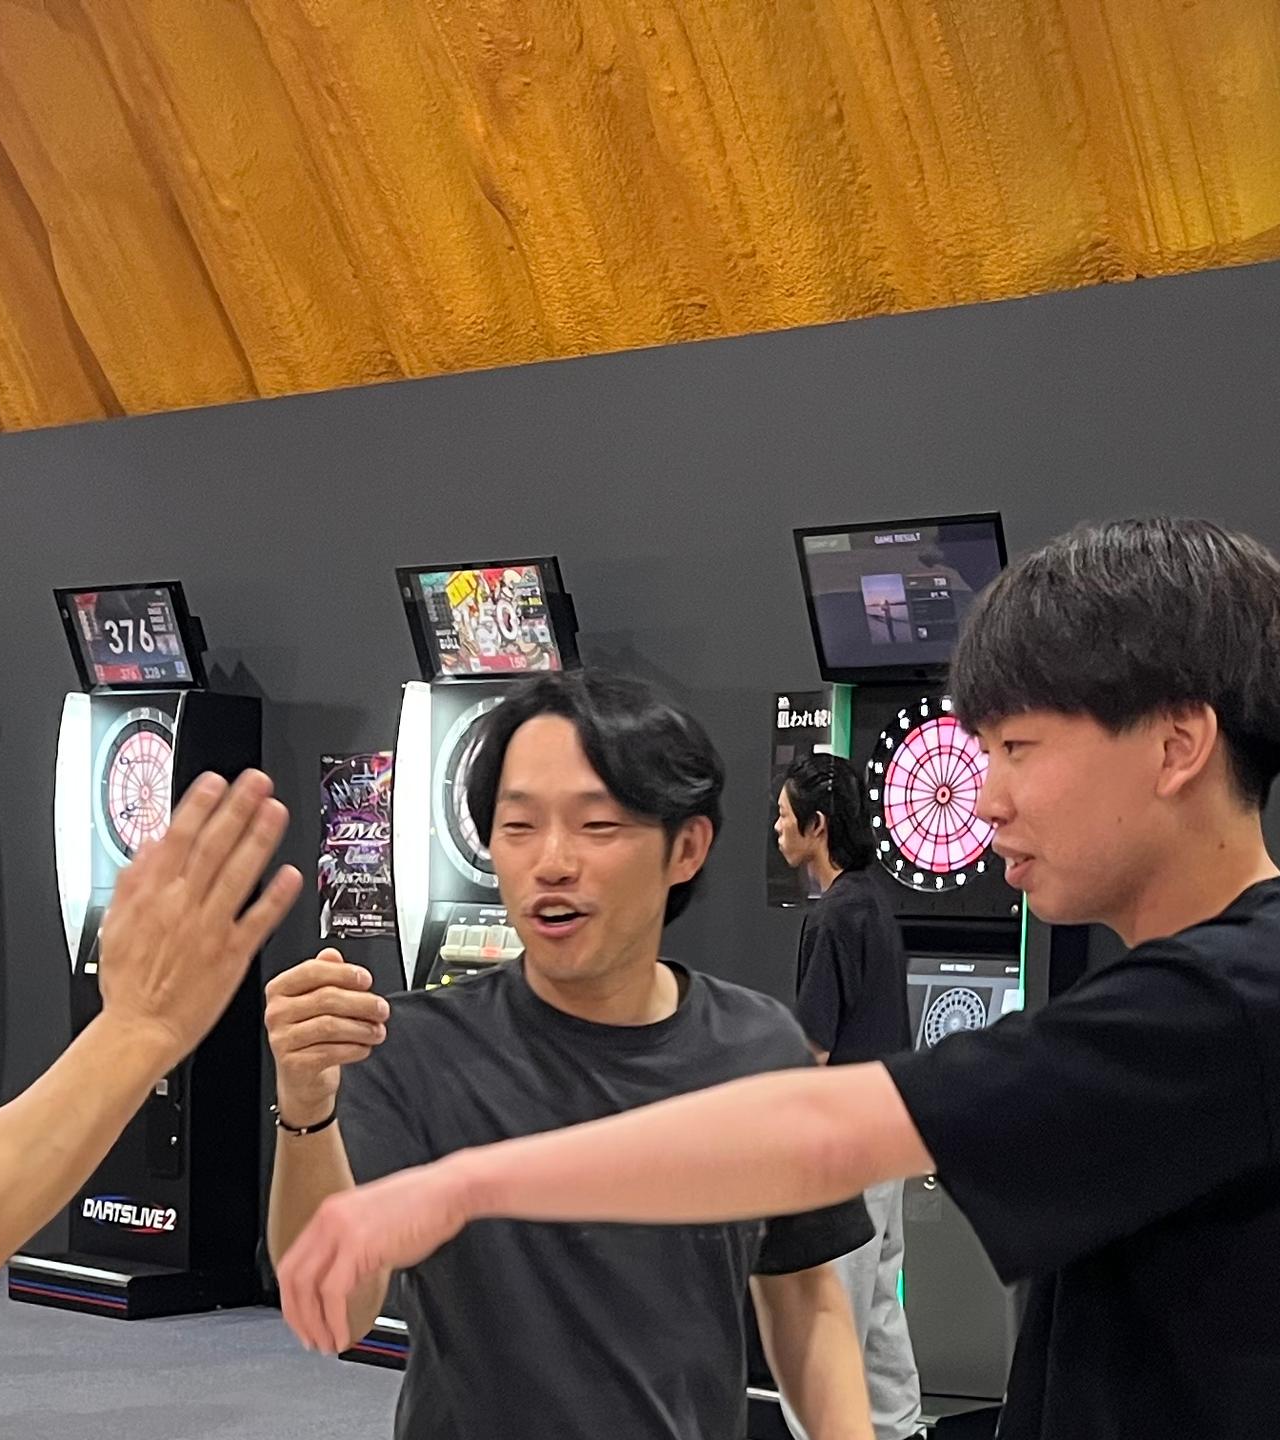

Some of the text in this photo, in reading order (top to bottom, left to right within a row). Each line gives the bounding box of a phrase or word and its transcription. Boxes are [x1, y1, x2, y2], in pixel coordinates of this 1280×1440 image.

[874, 534, 894, 545] GAME
[104, 619, 155, 654] 376
[82, 1197, 177, 1231] DARTSLIVE2
